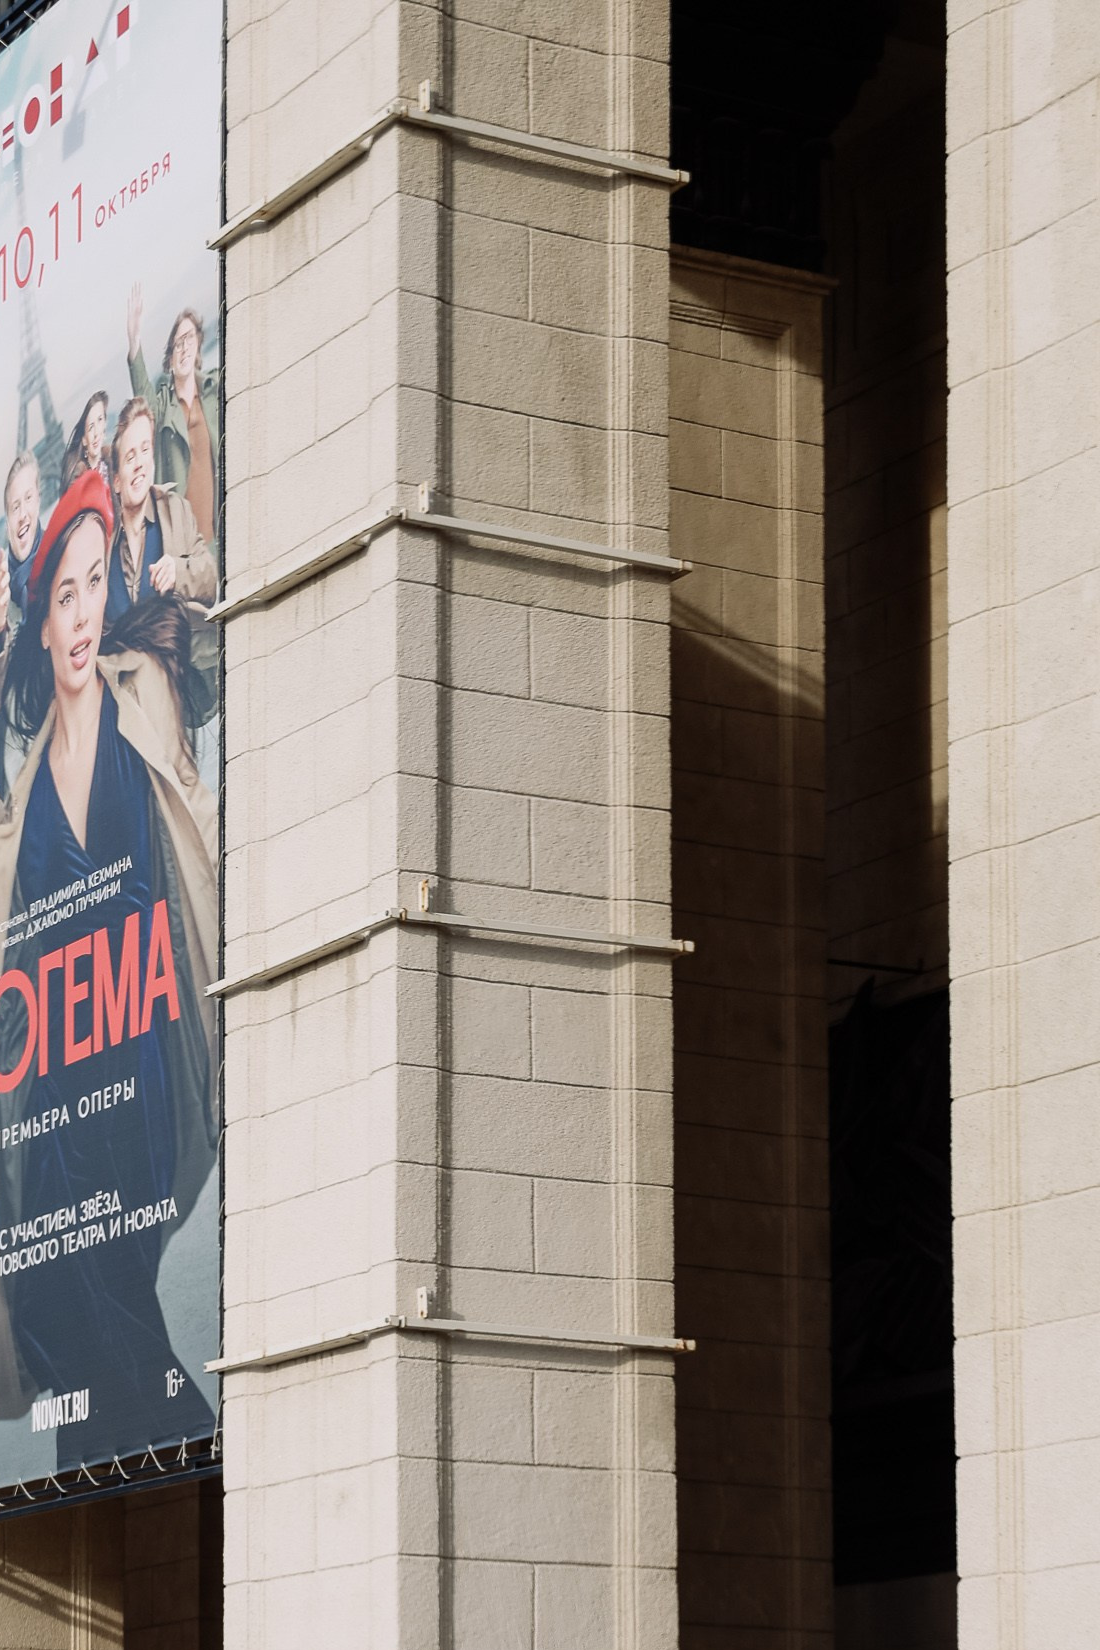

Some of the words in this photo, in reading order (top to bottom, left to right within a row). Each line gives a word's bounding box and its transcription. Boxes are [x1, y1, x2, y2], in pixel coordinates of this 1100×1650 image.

[94, 152, 171, 228] ОКТЯБРЯ
[25, 902, 73, 941] ДЖАКОМО
[75, 879, 121, 914] ПУЧЧИНИ
[29, 880, 86, 919] ВЛАДИМИРА
[87, 855, 133, 890] КЕХМАНА
[77, 1077, 135, 1119] ОПЕРЫ
[10, 1206, 76, 1248] УЧАСТИЕМ
[79, 1188, 122, 1221] ЗВЁЗД
[61, 1226, 106, 1256] ТЕАТРА
[109, 1218, 122, 1240] И
[124, 1196, 178, 1236] НОВАТА
[31, 1388, 90, 1433] NOVAT.RU
[165, 1368, 185, 1399] 16+
